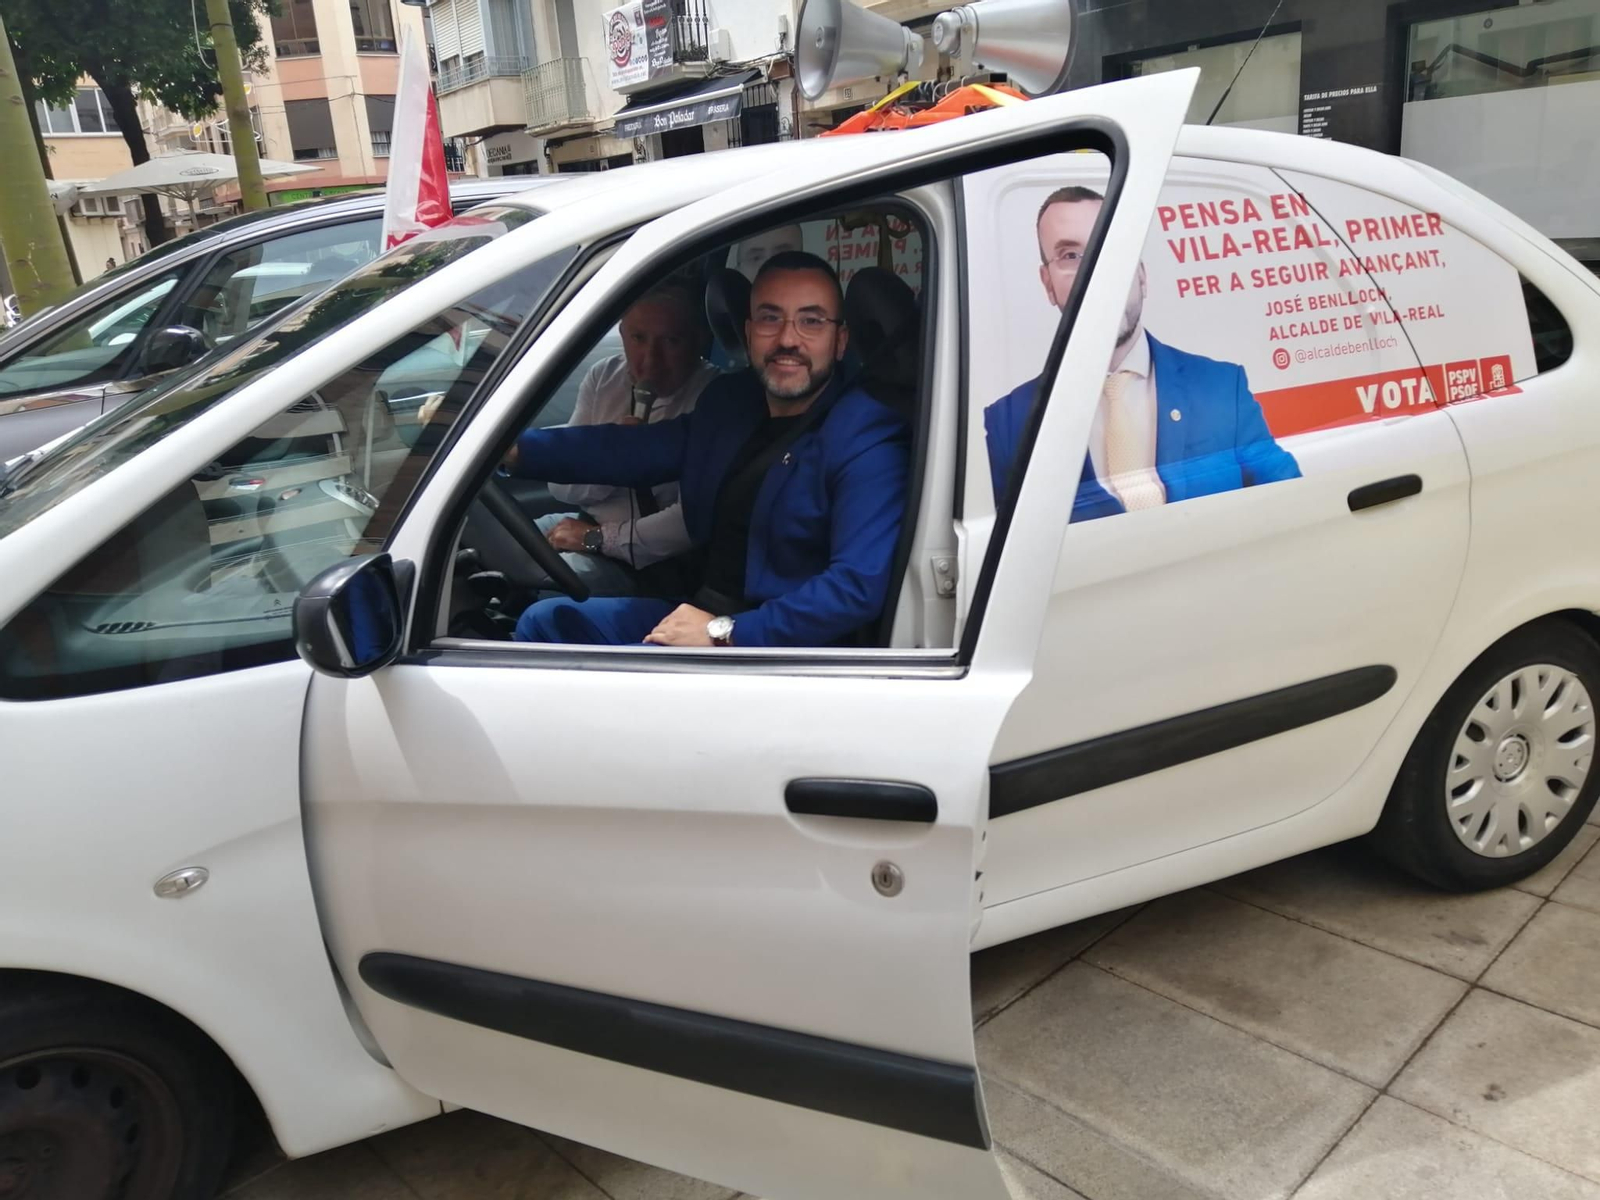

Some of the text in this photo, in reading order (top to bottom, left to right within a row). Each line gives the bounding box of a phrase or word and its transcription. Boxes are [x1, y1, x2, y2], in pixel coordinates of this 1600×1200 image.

[1328, 89, 1349, 97] PRECIOS
[1350, 87, 1364, 95] PARA
[1157, 192, 1311, 232] PENSA EN
[1167, 212, 1445, 264] VILA-REAL, PRIMER
[1176, 249, 1447, 298] PER A SEGUIR AVANÇANT,
[1265, 287, 1393, 317] JOSÉ BENLLOCH,
[1269, 304, 1445, 341] ALCALDE DE VILA-REAL
[1294, 335, 1398, 364] @alcaldebenlloch
[1355, 376, 1438, 413] VOTA
[1448, 367, 1476, 386] PSPV
